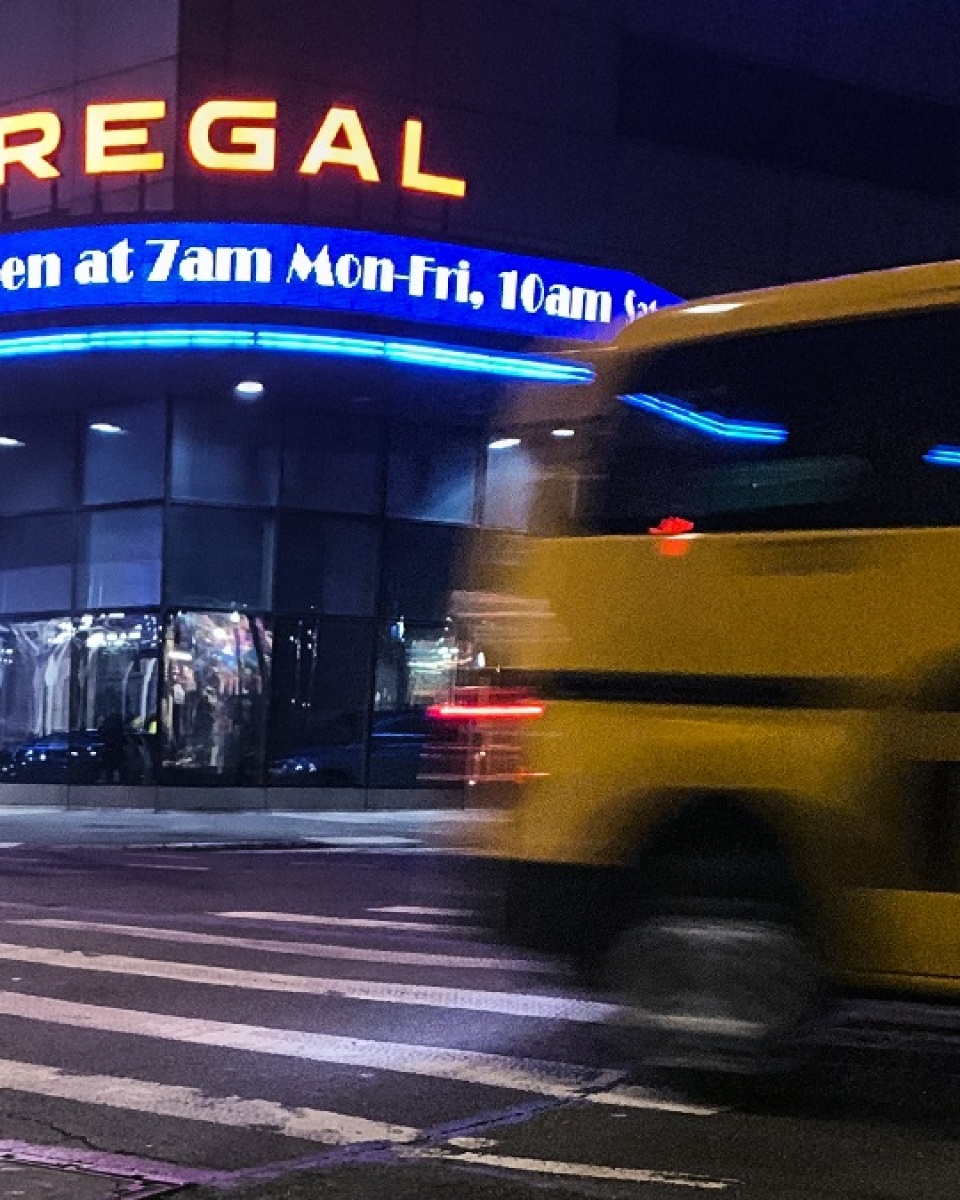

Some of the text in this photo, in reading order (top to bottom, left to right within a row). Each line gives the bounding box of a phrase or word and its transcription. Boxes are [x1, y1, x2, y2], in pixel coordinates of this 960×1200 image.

[74, 237, 135, 285] at
[145, 239, 272, 283] 7am
[285, 242, 485, 310] Mon-Fri,
[498, 268, 613, 323] 10am
